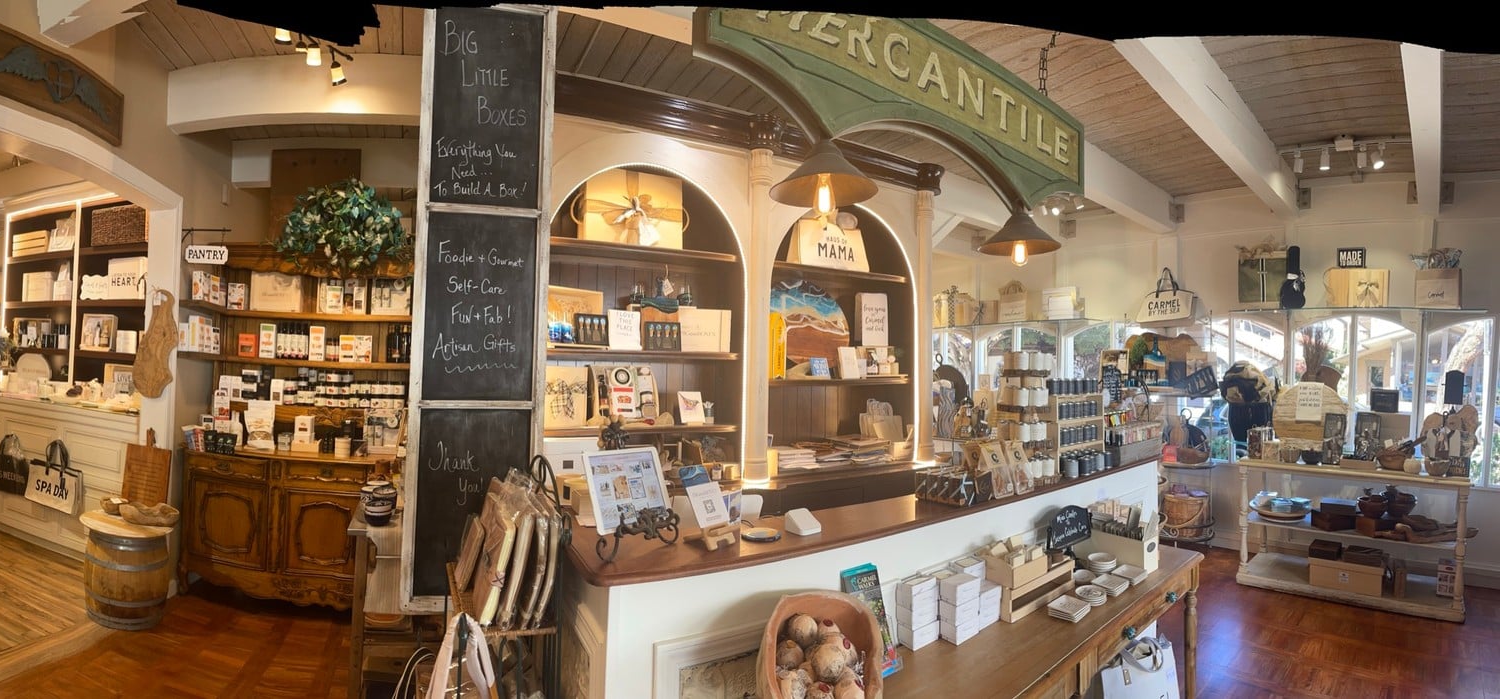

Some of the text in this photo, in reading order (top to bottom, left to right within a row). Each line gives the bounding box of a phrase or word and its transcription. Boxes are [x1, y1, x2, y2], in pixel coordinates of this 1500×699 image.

[444, 19, 478, 56] BIG
[462, 59, 510, 88] LITTLE
[477, 96, 527, 127] BOXES
[436, 136, 517, 168] Everything You
[433, 181, 448, 197] To
[453, 182, 480, 196] Build
[483, 183, 496, 198] A
[188, 248, 226, 260] PANTRY
[438, 240, 475, 266] Foodie
[487, 248, 524, 268] Gourmet
[817, 242, 855, 262] MAMA
[1339, 250, 1363, 262] MADE
[111, 276, 136, 287] HEART
[446, 275, 507, 295] Self-Care
[1148, 298, 1181, 310] CARMEL
[432, 333, 516, 361] Artisan Gifts
[428, 440, 480, 472] Thank
[35, 479, 69, 500] SPA DAY
